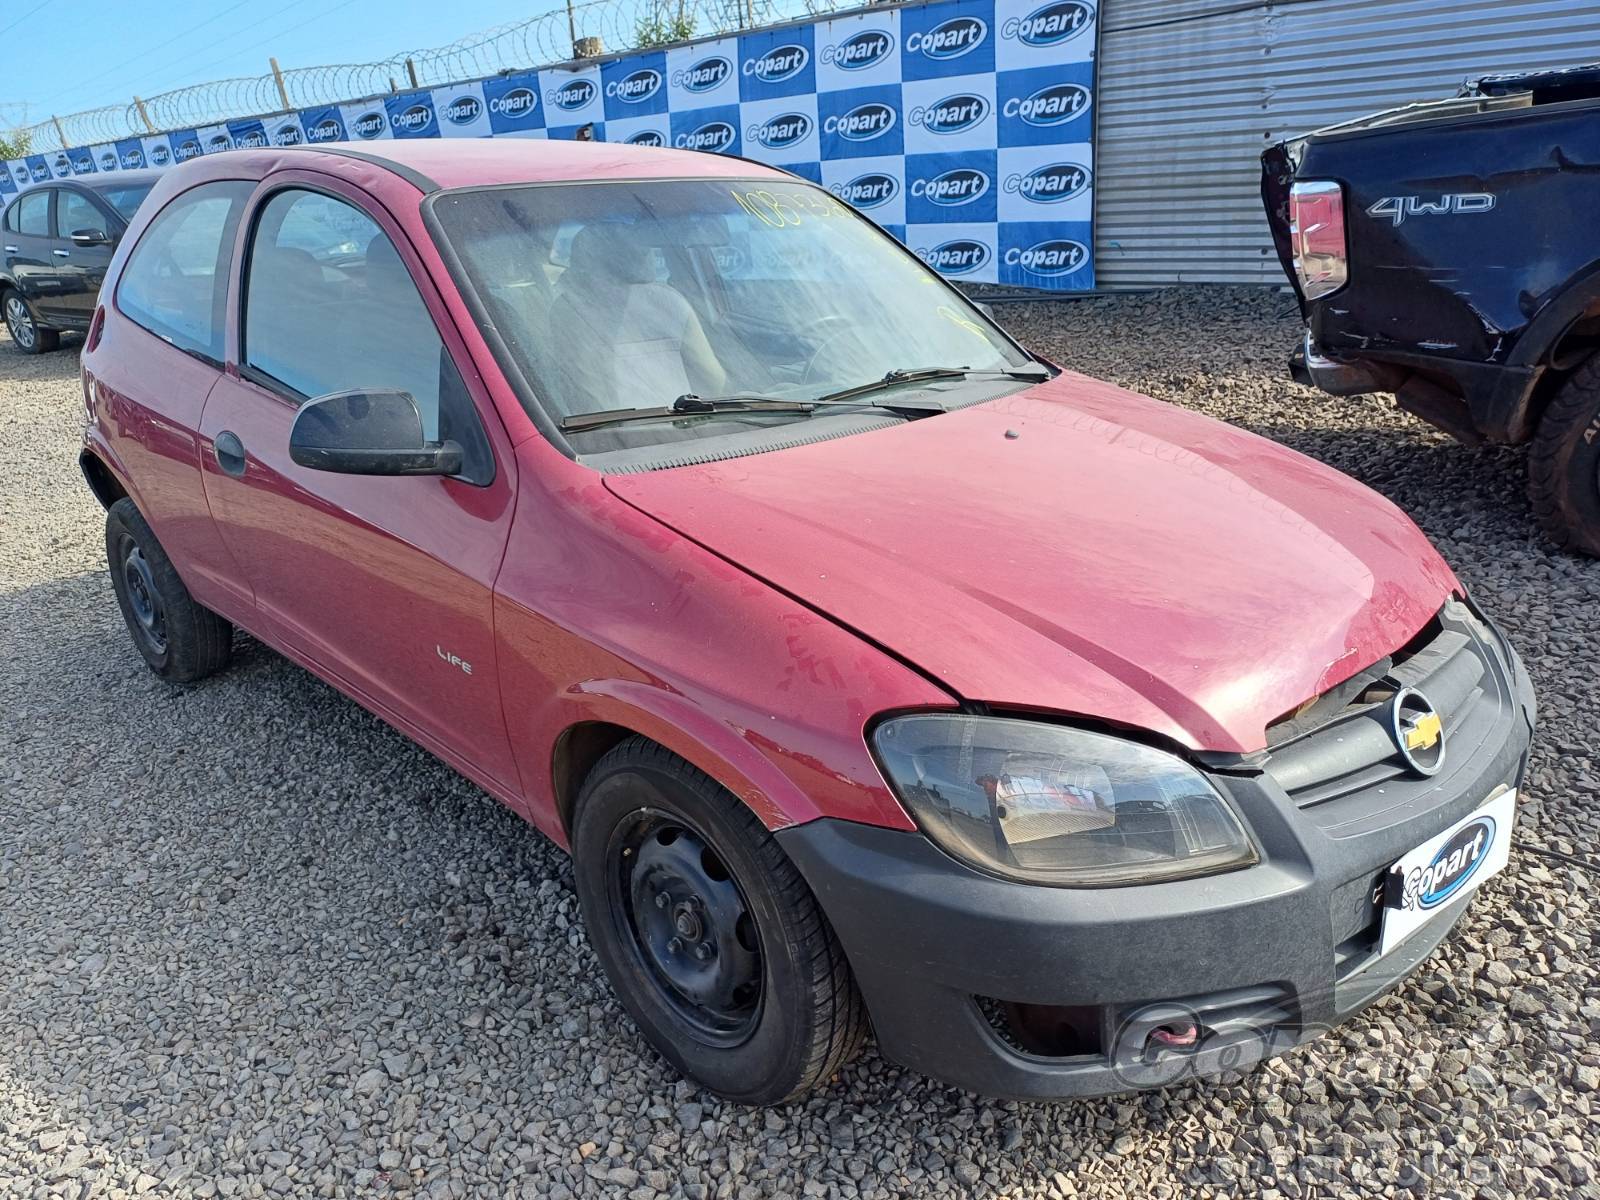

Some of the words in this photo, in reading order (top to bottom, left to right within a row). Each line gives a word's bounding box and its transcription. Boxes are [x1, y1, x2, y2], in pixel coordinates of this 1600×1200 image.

[1000, 6, 1083, 41] Copart
[820, 35, 886, 65] Copart
[906, 22, 978, 55] Copart
[743, 48, 801, 77] Copart
[606, 71, 658, 99] Copart
[671, 63, 726, 89] Copart
[490, 91, 532, 115] Copart
[545, 83, 592, 105] Copart
[1003, 90, 1084, 119] Copart
[391, 110, 427, 129] Copart
[439, 102, 478, 121] Copart
[824, 108, 888, 134] Copart
[908, 100, 979, 127] Copart
[308, 121, 339, 140] Copart
[675, 127, 729, 149] Copart
[746, 114, 805, 142] Copart
[174, 143, 197, 158] Copart
[831, 180, 890, 206] Copart
[911, 174, 981, 198] Copart
[1003, 168, 1081, 195] Copart
[1365, 192, 1496, 227] 4WD
[915, 246, 981, 267] Copart
[1004, 244, 1080, 268] Copart
[437, 644, 472, 675] LIFE
[1403, 828, 1483, 906] Copart
